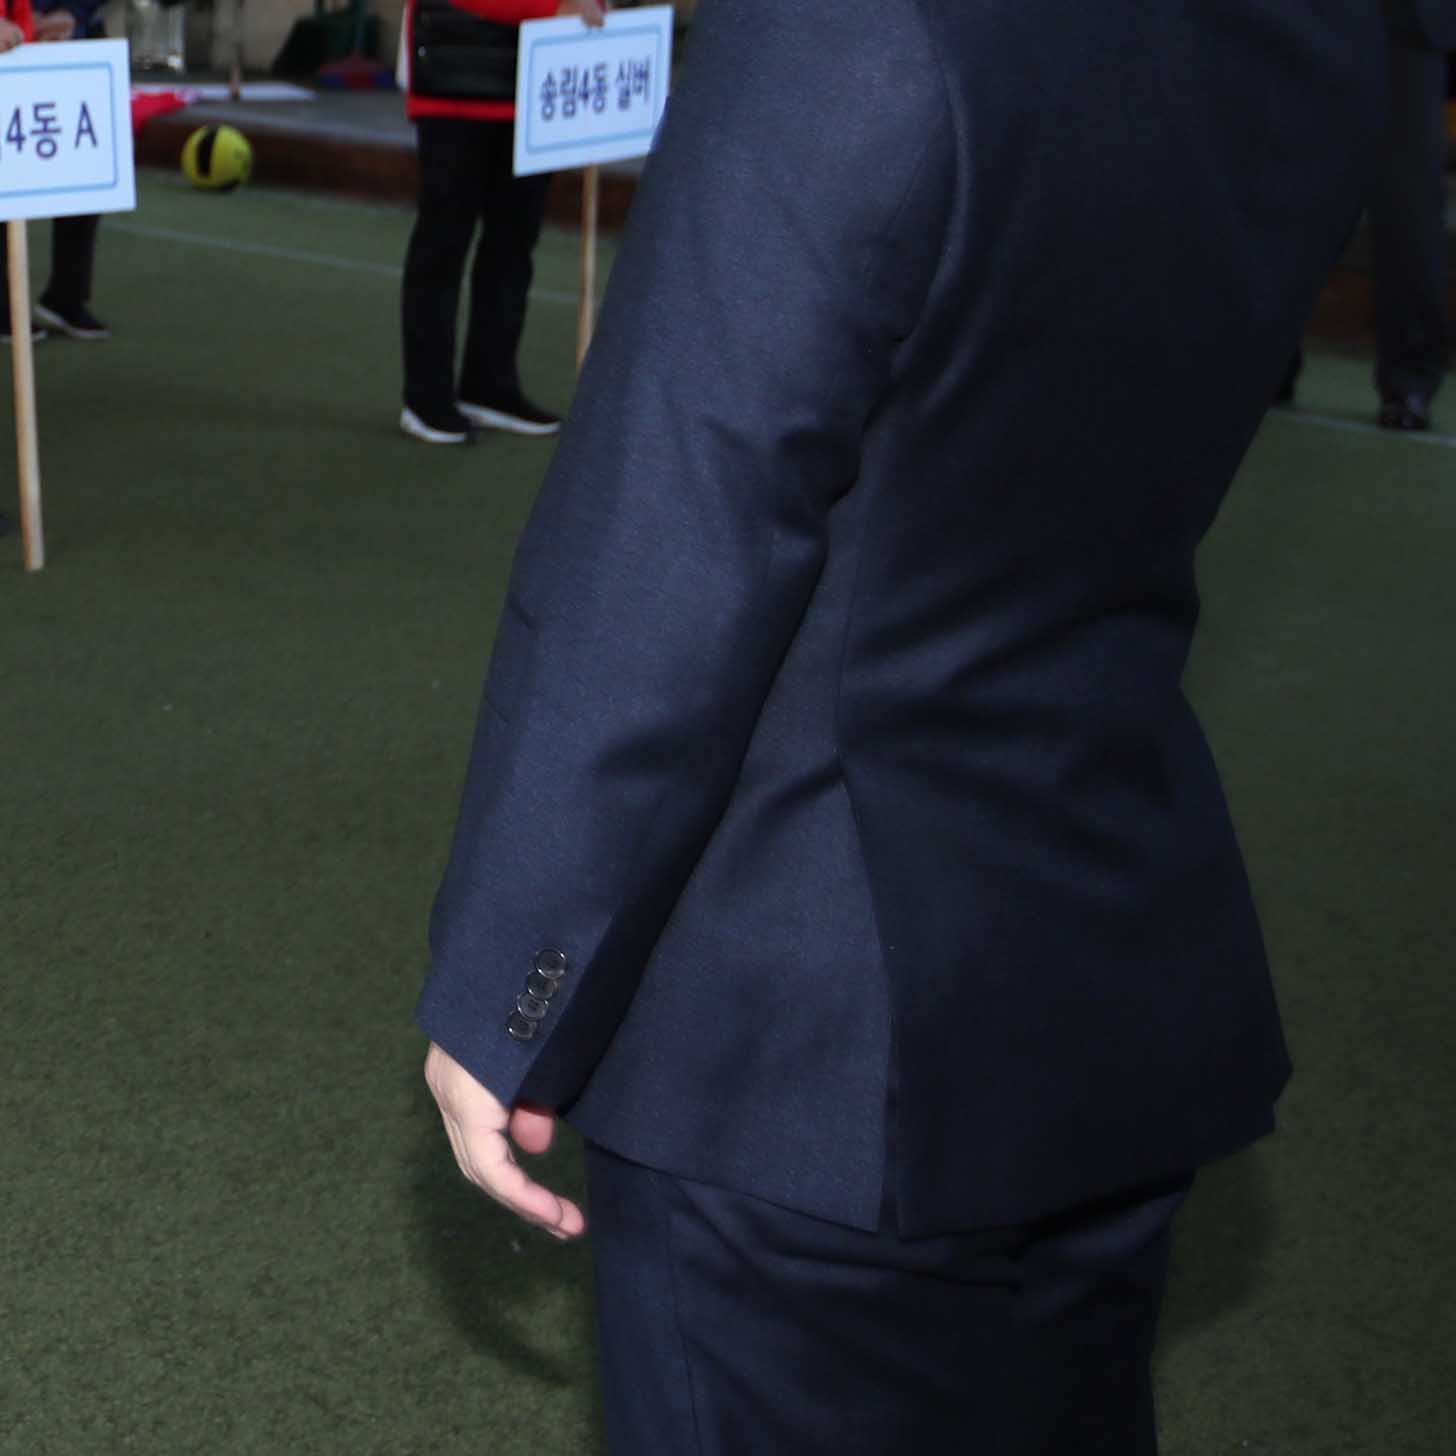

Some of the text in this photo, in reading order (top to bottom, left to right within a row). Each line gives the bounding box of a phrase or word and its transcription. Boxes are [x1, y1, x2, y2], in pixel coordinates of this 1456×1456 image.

[540, 54, 650, 122] 송림4동 실버
[74, 100, 99, 150] A
